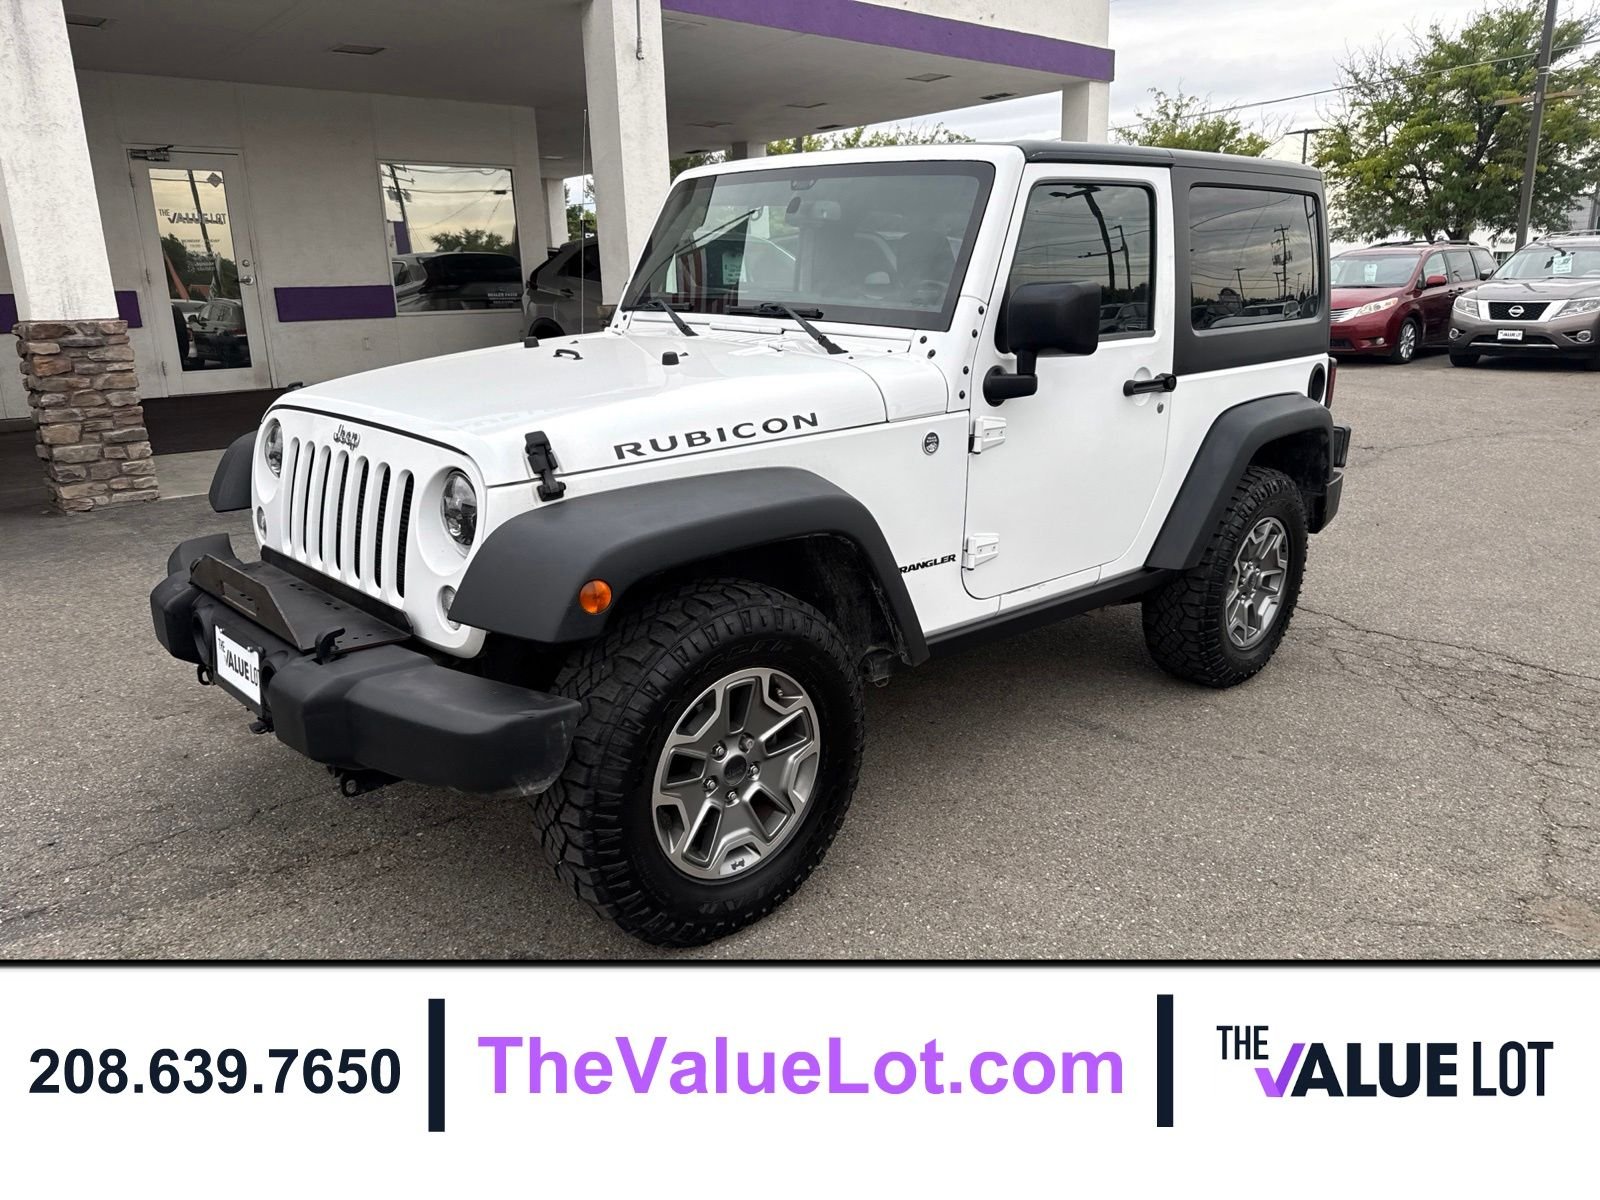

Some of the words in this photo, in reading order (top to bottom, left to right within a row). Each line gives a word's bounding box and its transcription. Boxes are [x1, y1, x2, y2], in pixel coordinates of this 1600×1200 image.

[158, 208, 170, 217] THE
[333, 423, 361, 451] Jeep
[613, 412, 818, 460] RUBICON
[899, 554, 956, 573] RANGLER
[224, 649, 250, 681] VALUE
